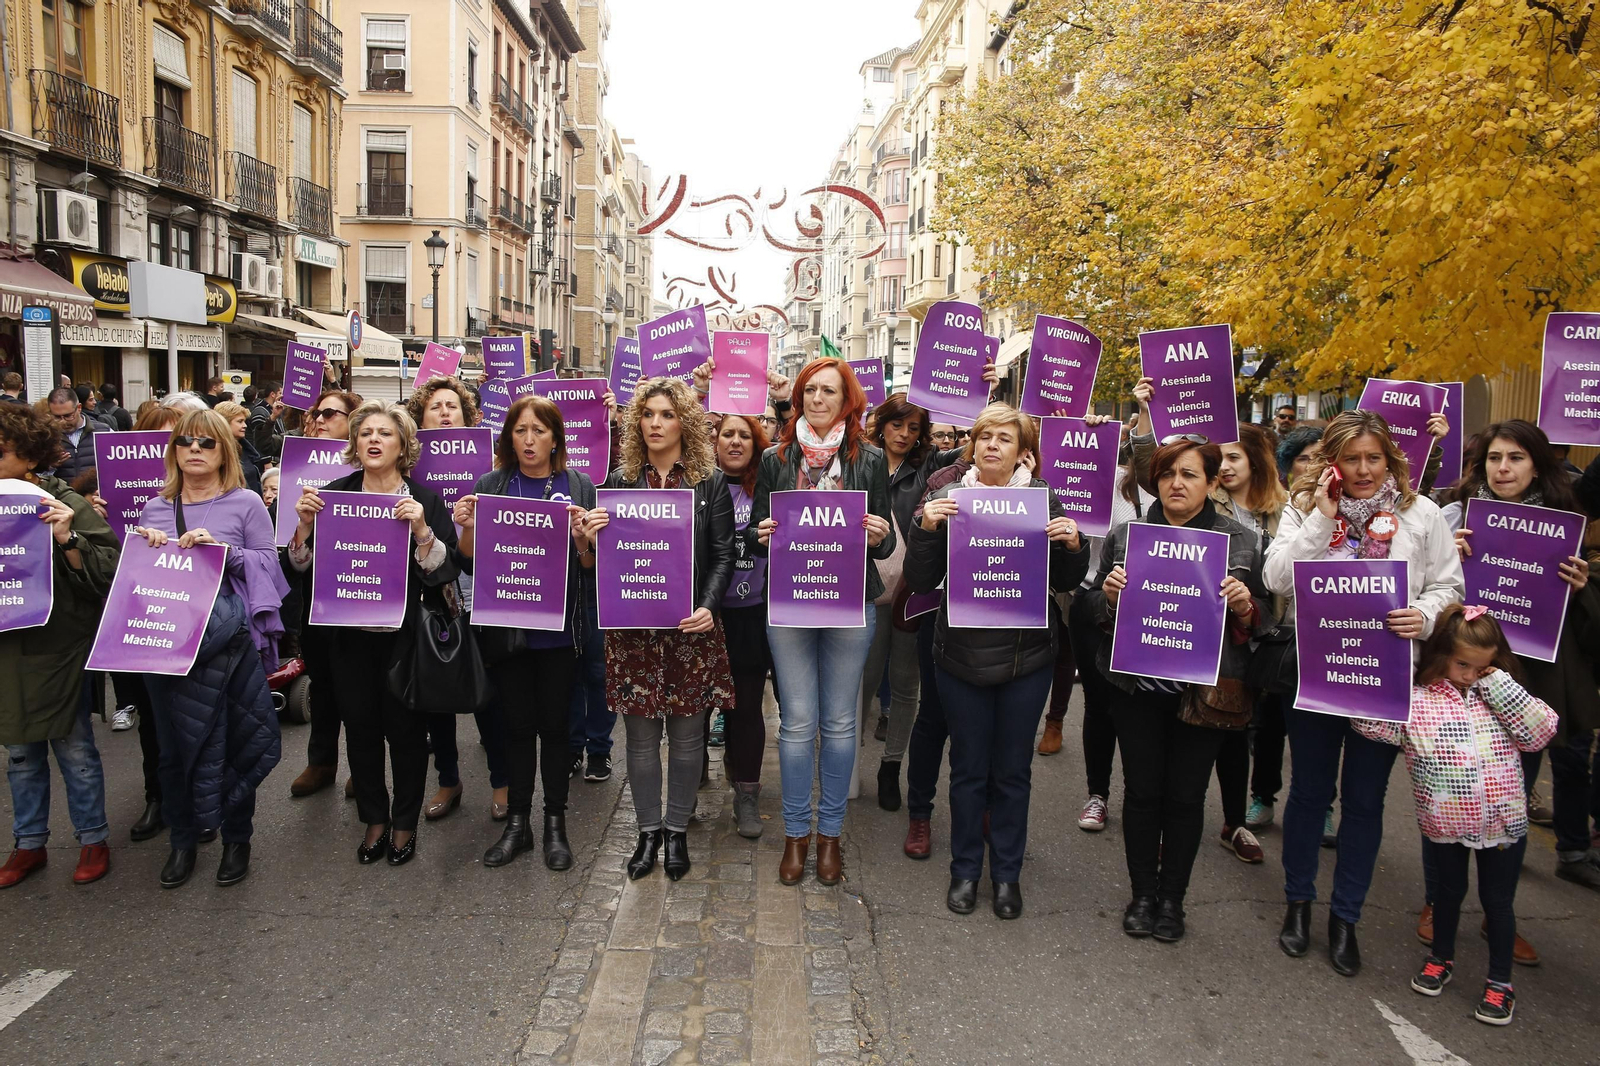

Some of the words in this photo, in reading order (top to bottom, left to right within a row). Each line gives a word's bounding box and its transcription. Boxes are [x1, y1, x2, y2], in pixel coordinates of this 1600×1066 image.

[945, 312, 982, 332] ROSA
[651, 318, 694, 340] DONNA
[1048, 326, 1090, 344] VIRGINIA
[98, 328, 109, 342] DE
[111, 328, 142, 344] CHUFAS
[186, 334, 221, 348] ARTESANOS
[652, 345, 693, 361] Asesinada
[933, 341, 977, 356] Asesinada
[1165, 342, 1209, 362] ANA
[294, 349, 320, 362] NOELIA
[1043, 354, 1080, 367] Asesinada
[667, 362, 680, 372] por
[946, 359, 960, 367] por
[293, 366, 314, 375] Asesinada
[854, 366, 877, 375] PILAR
[932, 369, 969, 382] violencia
[293, 382, 311, 390] violencia
[1042, 379, 1073, 391] violencia
[1161, 374, 1211, 386] Asesinada
[1581, 379, 1599, 388] por
[292, 388, 310, 398] Machista
[488, 384, 509, 395] GLOR
[516, 384, 533, 394] ANG
[547, 390, 596, 400] ANTONIA
[930, 382, 968, 396] Machista
[1180, 390, 1195, 400] por
[1040, 390, 1071, 403] Machista
[1382, 391, 1420, 407] ERIKA
[1167, 401, 1210, 413] violencia
[1170, 415, 1213, 428] Machista
[1061, 431, 1098, 449] ANA
[430, 440, 477, 454] SOFIA
[307, 450, 342, 465] ANA
[1054, 460, 1097, 471] Asesinada
[426, 471, 473, 480] Asesinada
[114, 477, 165, 489] Asesinada
[443, 488, 458, 496] por
[1054, 487, 1091, 498] violencia
[133, 495, 149, 504] por
[617, 504, 680, 520] RAQUEL
[973, 500, 1027, 514] PAULA
[1062, 502, 1092, 513] achista
[493, 510, 553, 528] JOSEFA
[799, 507, 846, 526] ANA
[1487, 514, 1565, 539] CATALINA
[334, 540, 386, 552] Asesinada
[617, 540, 669, 550] Asesinada
[789, 541, 842, 551] Asesinada
[969, 537, 1024, 547] Asesinada
[494, 543, 545, 555] Asesinada
[1148, 541, 1207, 562] JENNY
[154, 553, 192, 571] ANA
[352, 560, 368, 569] por
[511, 562, 527, 571] por
[635, 559, 651, 568] por
[808, 560, 824, 569] por
[988, 556, 1005, 566] por
[1481, 553, 1543, 574] Asesinada
[337, 572, 381, 584] violencia
[496, 574, 540, 586] violencia
[620, 573, 665, 583] violencia
[792, 573, 838, 583] violencia
[973, 570, 1020, 580] violencia
[1311, 576, 1395, 593] CARMEN
[1498, 576, 1519, 587] por
[133, 585, 190, 601] Asesinada
[337, 588, 382, 600] Machista
[622, 589, 667, 599] Machista
[794, 589, 839, 599] Machista
[974, 587, 1021, 597] Machista
[1142, 580, 1200, 596] Asesinada
[497, 590, 541, 601] Machista
[1479, 588, 1532, 608] violencia
[146, 605, 166, 614] por
[1160, 602, 1179, 612] por
[1320, 618, 1383, 629] Asesinada
[1482, 609, 1531, 626] achista
[128, 618, 176, 632] violencia
[1143, 616, 1192, 632] violencia
[123, 634, 173, 648] Machista
[1142, 633, 1192, 650] Machista
[1342, 638, 1362, 648] por
[1325, 653, 1378, 667] violencia
[1327, 671, 1381, 686] Machista
